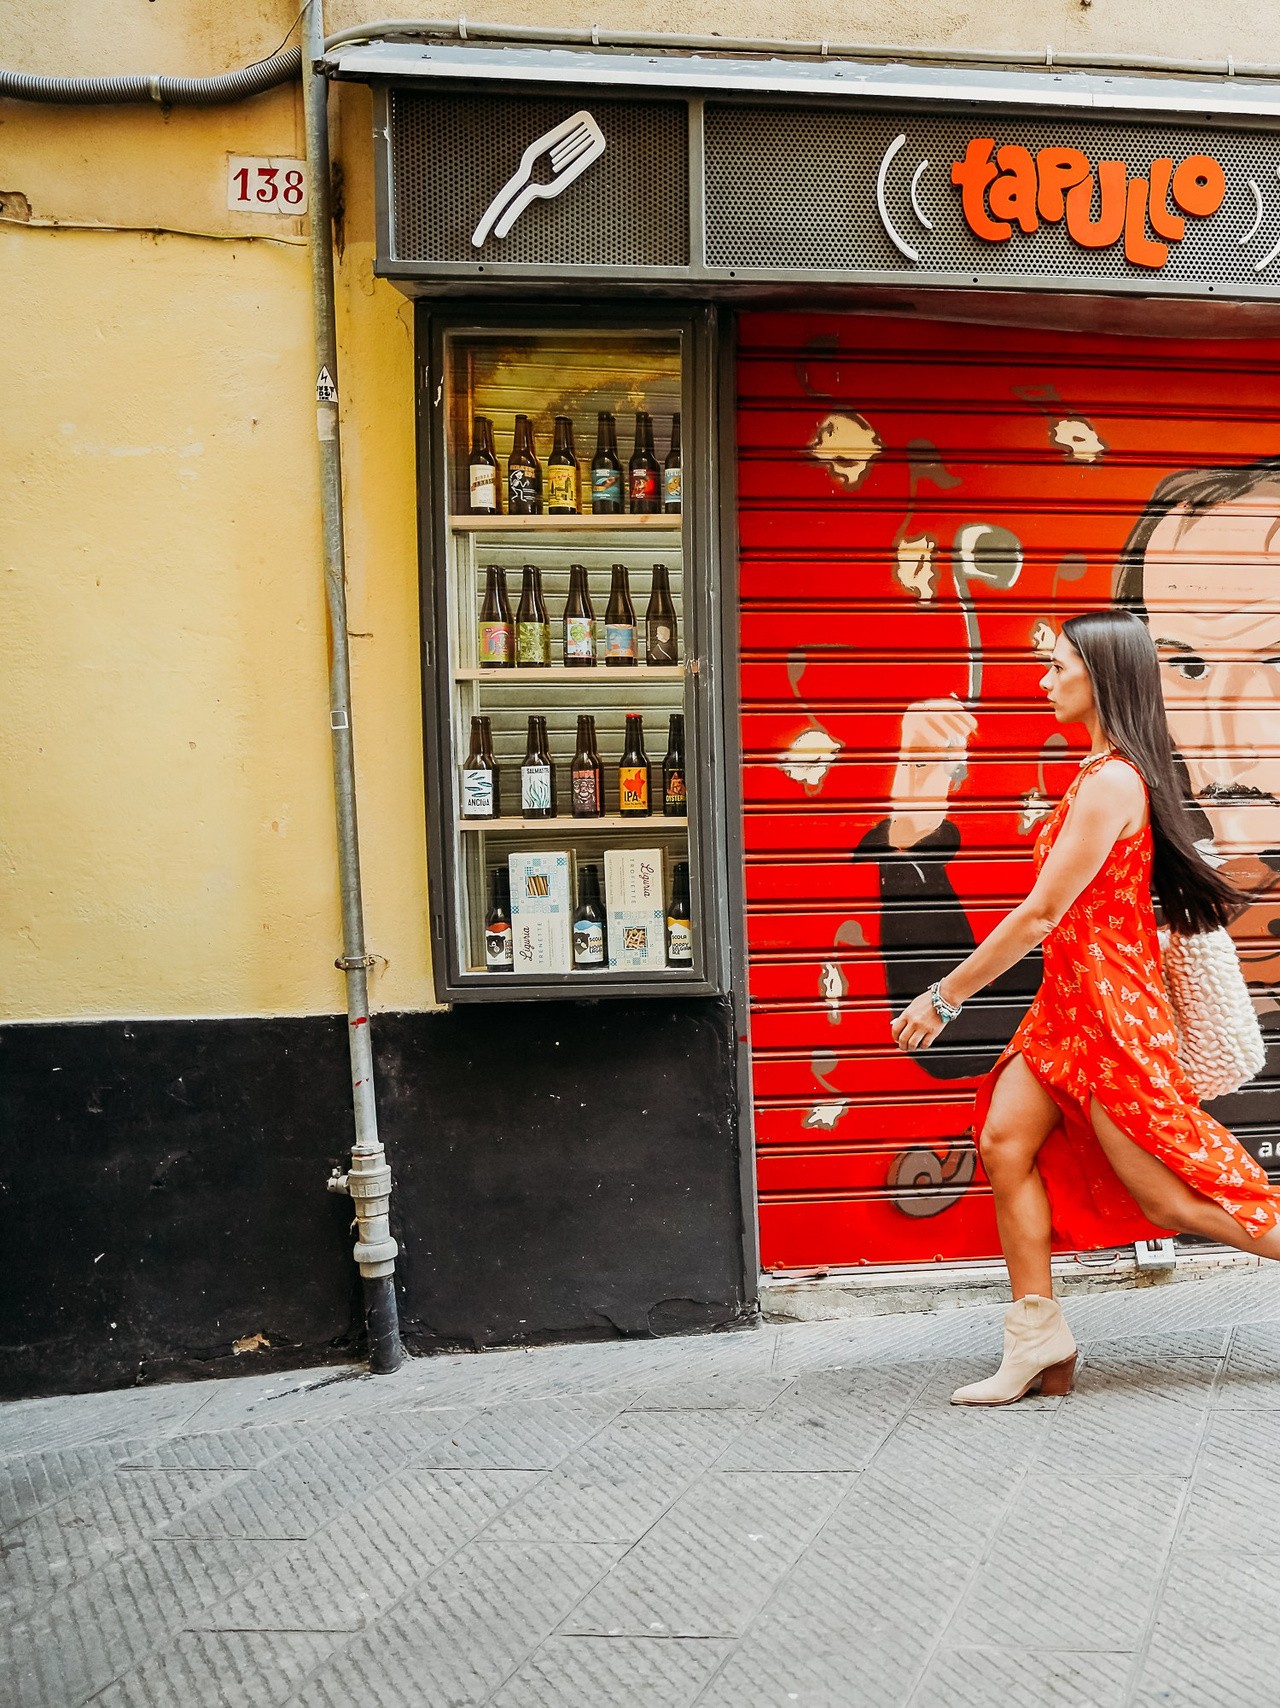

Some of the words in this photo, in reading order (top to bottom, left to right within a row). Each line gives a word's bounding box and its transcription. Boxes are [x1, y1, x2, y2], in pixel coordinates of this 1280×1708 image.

[231, 166, 306, 206] 138
[624, 791, 639, 802] IPA
[638, 862, 655, 898] Liguria
[519, 925, 535, 962] Liguria
